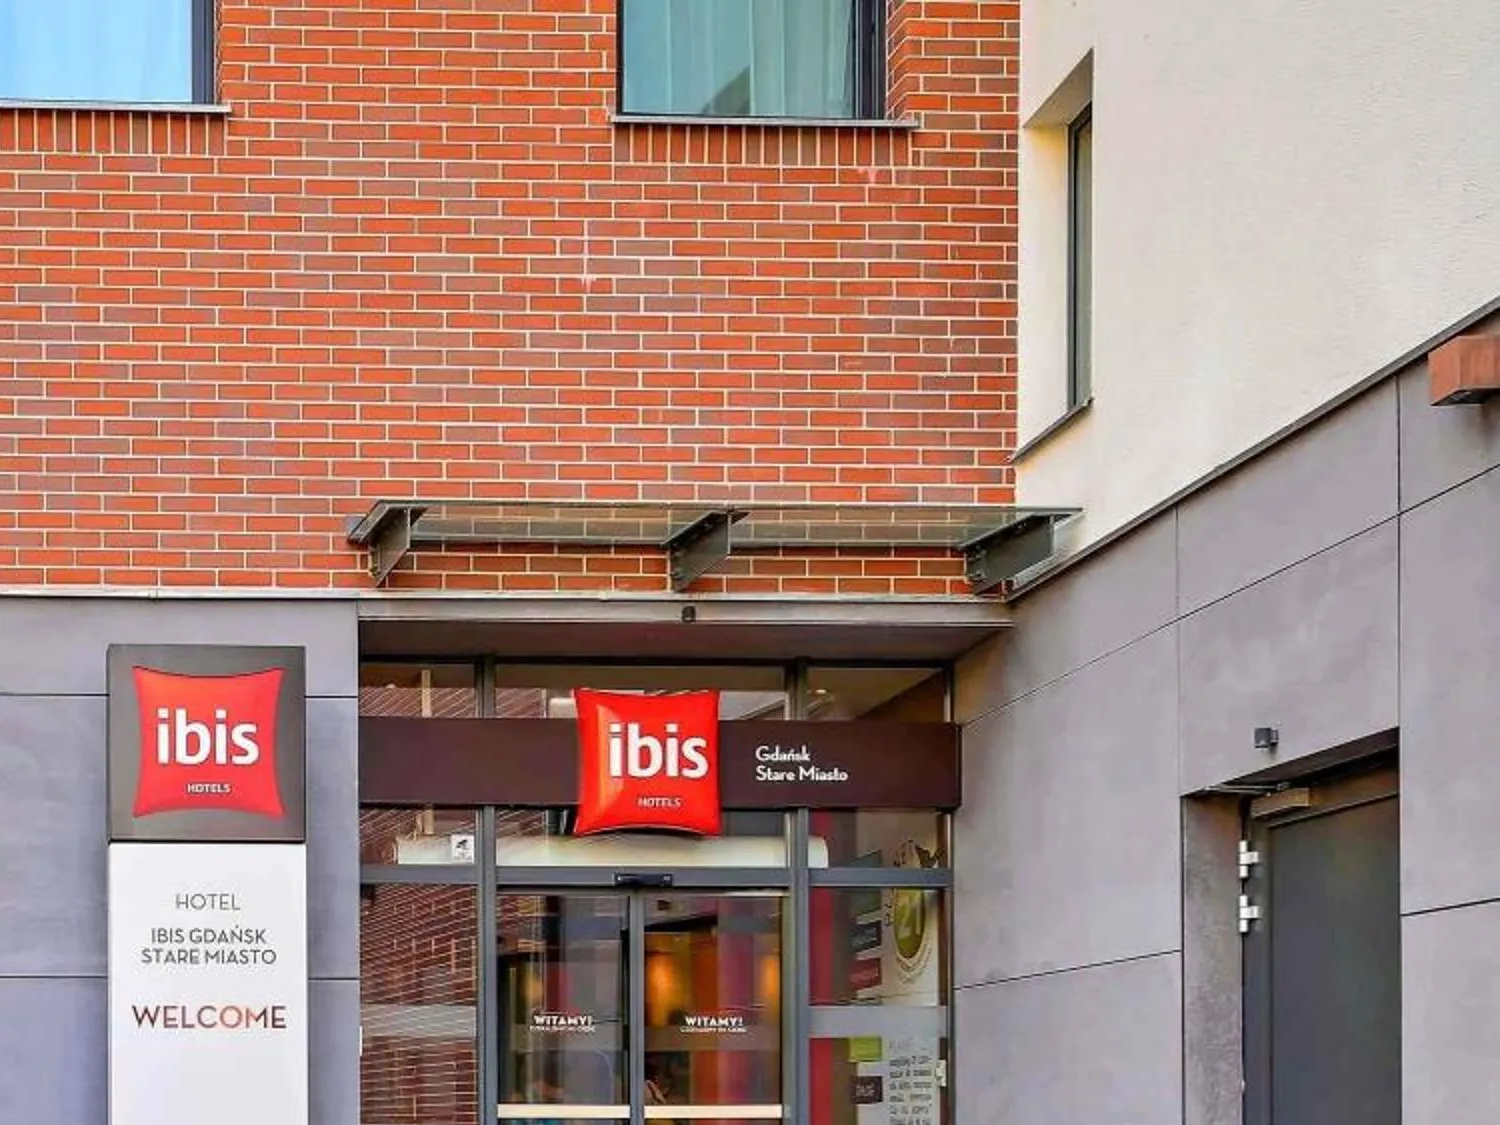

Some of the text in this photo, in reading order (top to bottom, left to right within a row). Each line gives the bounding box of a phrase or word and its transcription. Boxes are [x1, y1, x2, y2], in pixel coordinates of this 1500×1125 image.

[157, 708, 260, 766] ibis
[609, 722, 709, 779] ibis
[755, 745, 811, 761] Gdańsk
[756, 765, 849, 781] Stare Miasto
[187, 783, 231, 794] HOTELS
[637, 797, 682, 808] HOTELS
[175, 893, 241, 911] HOTEL
[151, 925, 266, 944] IBIS GDAŃSK
[141, 949, 277, 965] STARE MIASTO
[132, 1005, 287, 1029] WELCOME
[684, 1016, 743, 1027] WITAMY!
